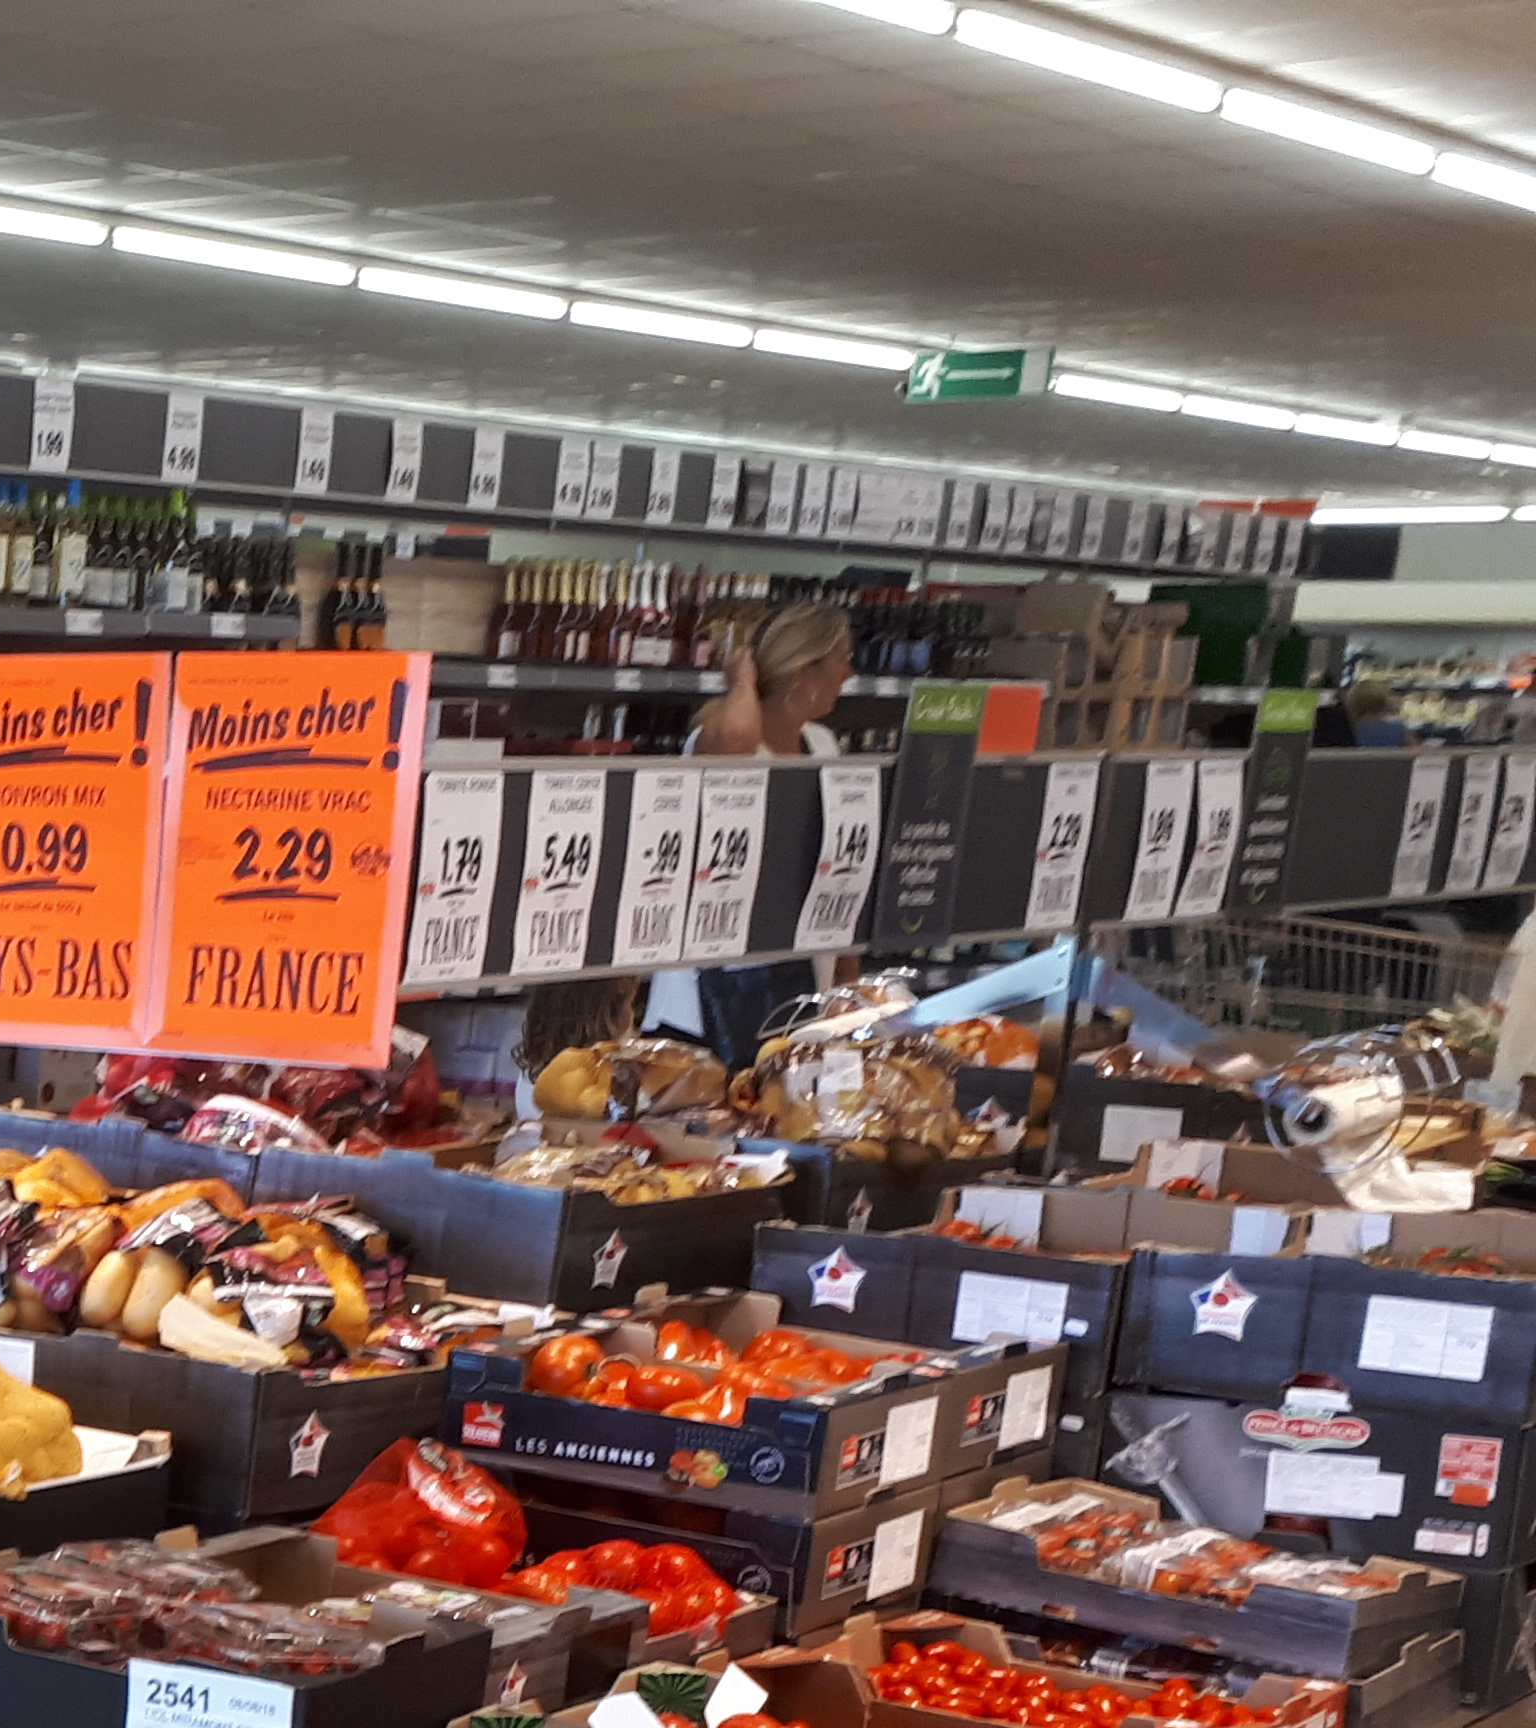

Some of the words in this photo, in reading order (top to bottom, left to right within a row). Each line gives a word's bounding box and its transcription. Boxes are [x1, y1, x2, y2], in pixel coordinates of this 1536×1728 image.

[54, 687, 123, 738] cher
[188, 700, 287, 754] Moins
[297, 687, 375, 739] cher
[72, 784, 107, 807] MIX
[204, 787, 313, 812] NECTARINE
[318, 789, 372, 813] VRAC
[1, 821, 89, 874] 0.99
[232, 825, 335, 883] 2.29
[440, 836, 483, 885] 1.79
[542, 831, 592, 880] 5.49
[182, 942, 365, 1017] FRANCE
[515, 1436, 548, 1455] LES
[553, 1438, 657, 1469] ANCIENNES
[146, 1677, 211, 1714] 2541
